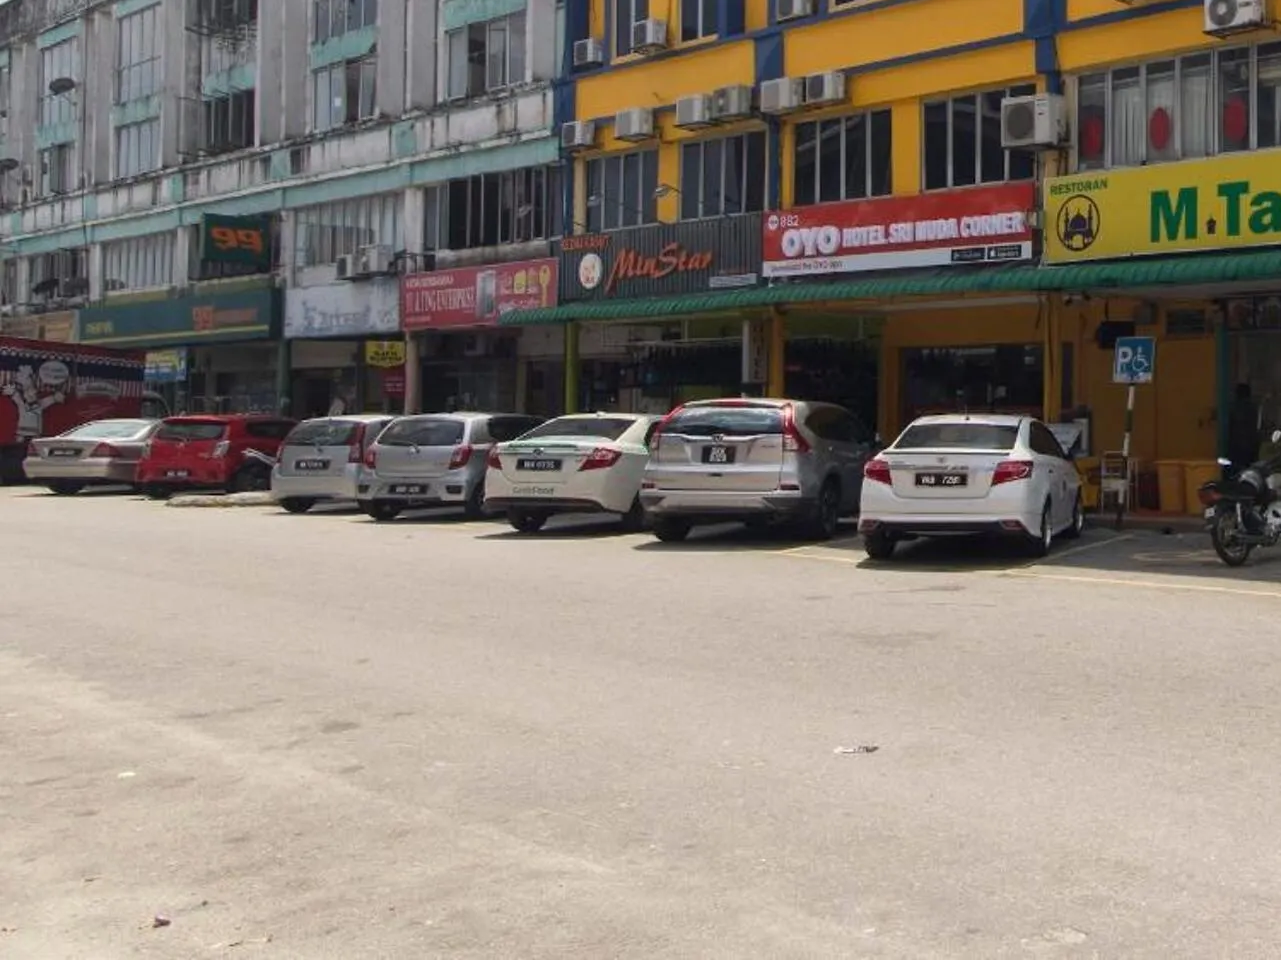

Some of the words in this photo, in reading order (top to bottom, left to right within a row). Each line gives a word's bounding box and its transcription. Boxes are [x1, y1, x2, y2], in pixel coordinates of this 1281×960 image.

[1050, 178, 1108, 196] RESTORAN
[780, 215, 799, 228] 882
[781, 226, 841, 258] OYO
[842, 225, 888, 248] HOTEL
[888, 222, 914, 243] SRI
[915, 218, 958, 241] MUDA
[960, 212, 1026, 237] CORNER
[1118, 346, 1131, 374] P
